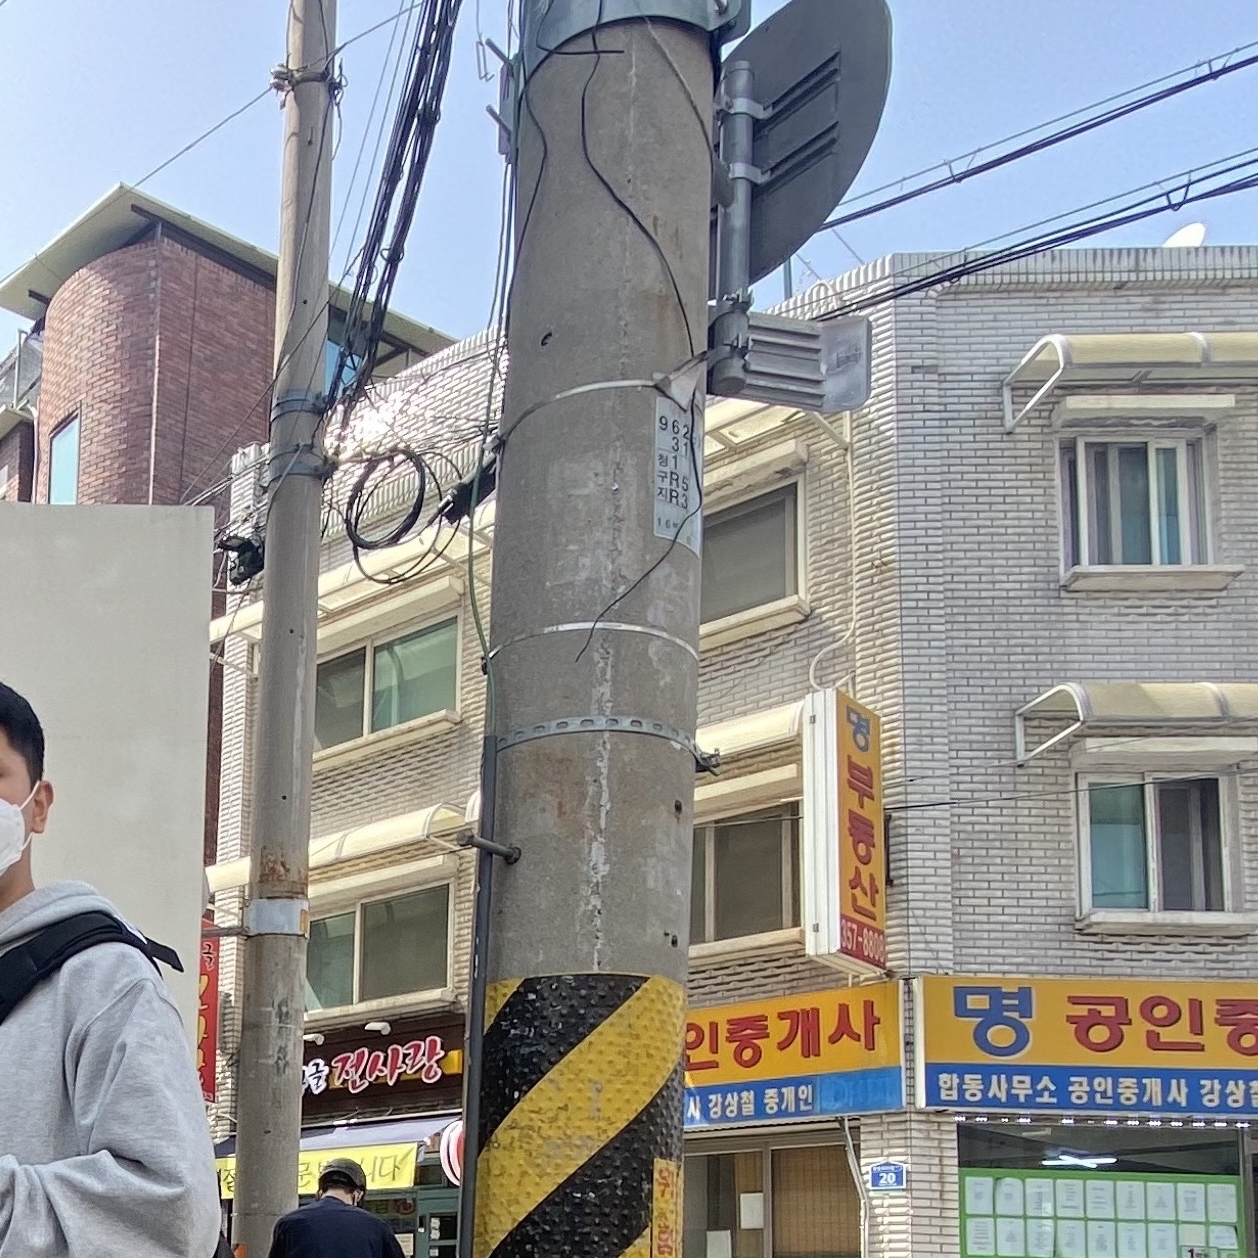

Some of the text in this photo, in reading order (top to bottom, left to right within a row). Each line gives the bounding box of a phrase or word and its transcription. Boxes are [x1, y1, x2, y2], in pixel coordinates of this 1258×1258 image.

[846, 706, 879, 922] 명 부동산
[953, 986, 1034, 1058] 명
[332, 1035, 445, 1094] 전사랑
[764, 1083, 813, 1114] 중개인
[938, 1073, 1058, 1104] 합동사무소
[1068, 1076, 1188, 1107] 공인중개사
[879, 1172, 897, 1184] 20
